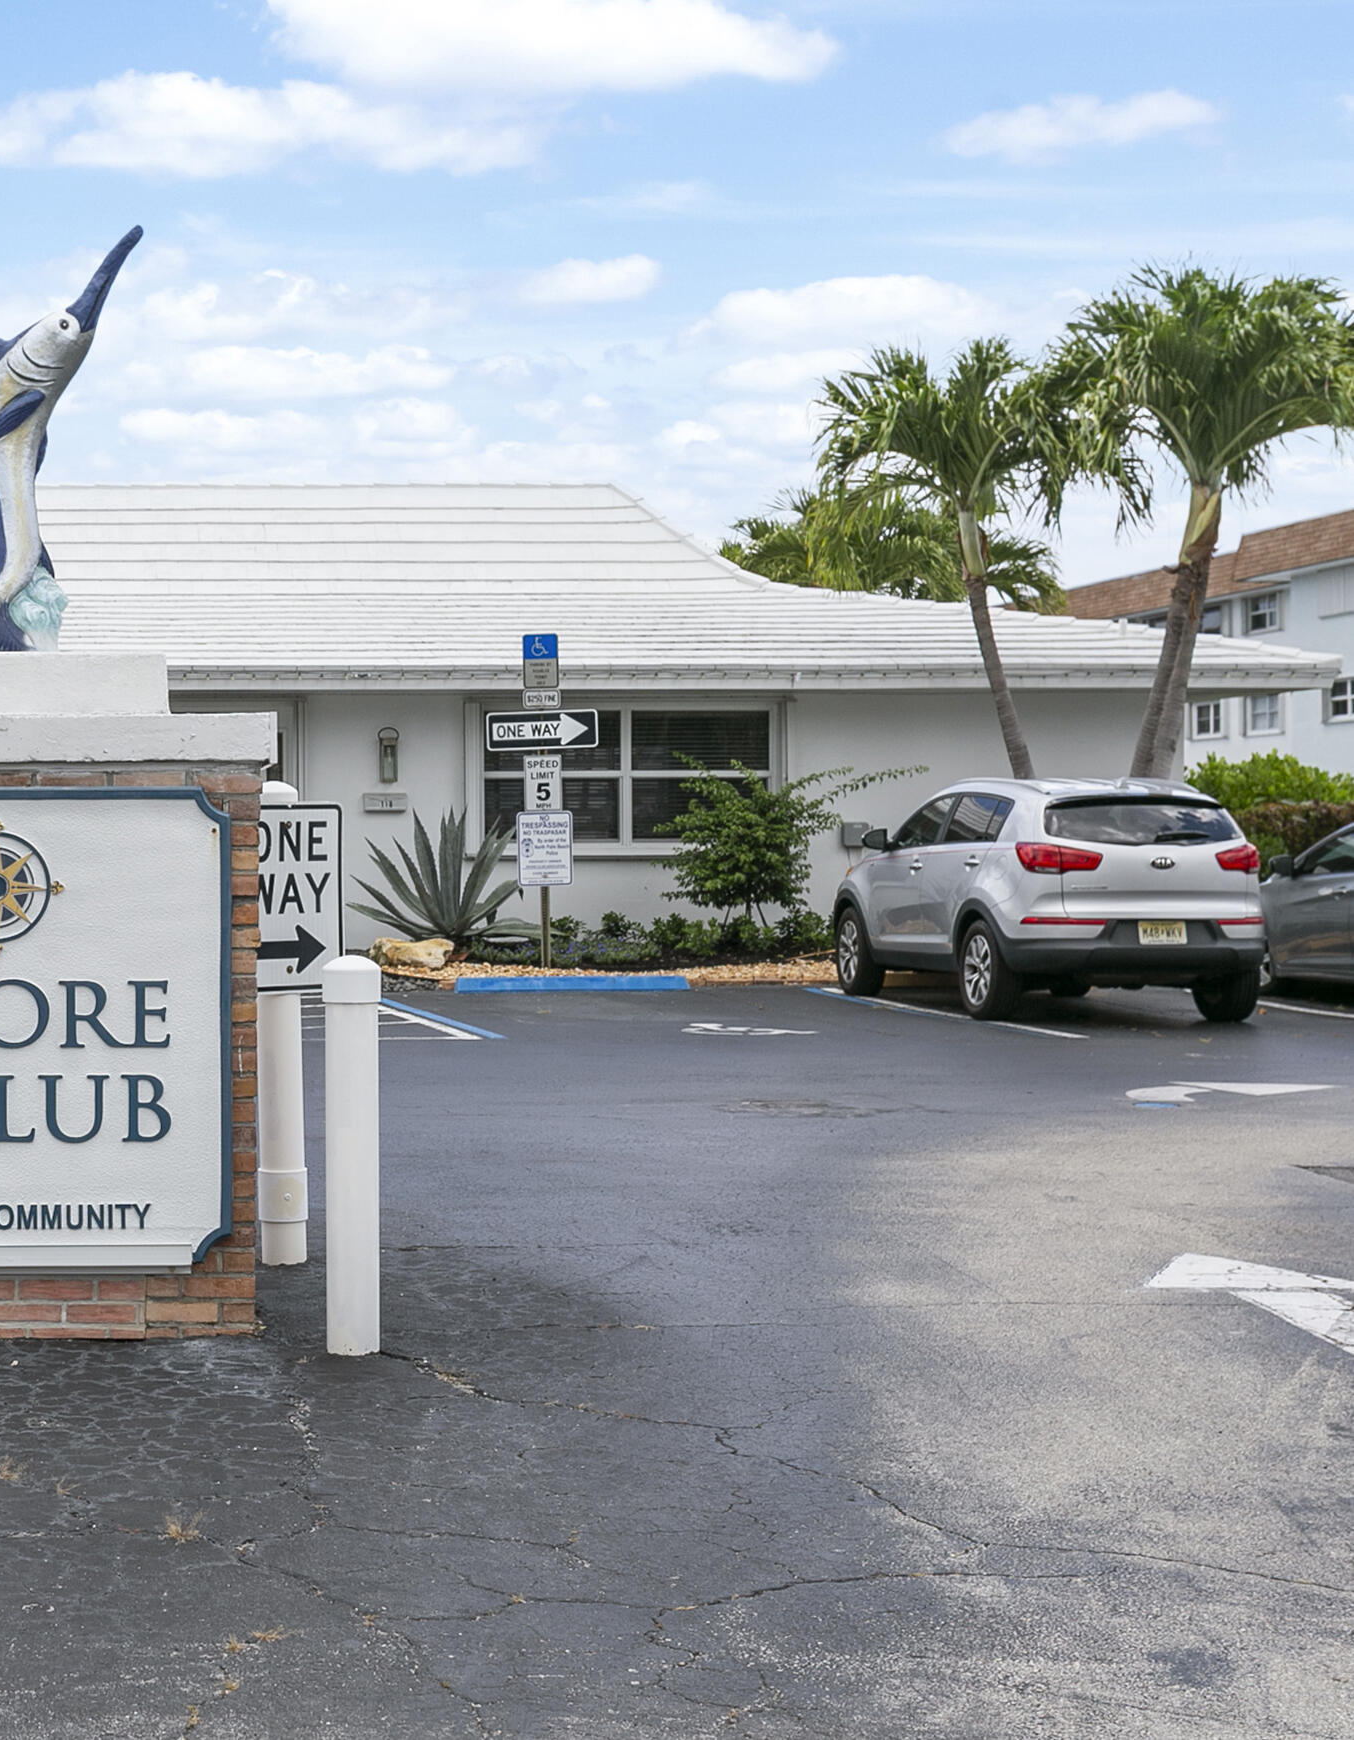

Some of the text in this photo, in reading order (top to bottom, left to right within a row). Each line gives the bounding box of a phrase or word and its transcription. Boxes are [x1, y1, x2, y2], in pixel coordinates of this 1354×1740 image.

[497, 722, 560, 738] ONE WAY
[527, 760, 559, 769] SPEED
[530, 771, 555, 780] LIMIT
[536, 782, 551, 801] 5
[539, 814, 550, 822] NO
[521, 821, 568, 829] TRESPASSING
